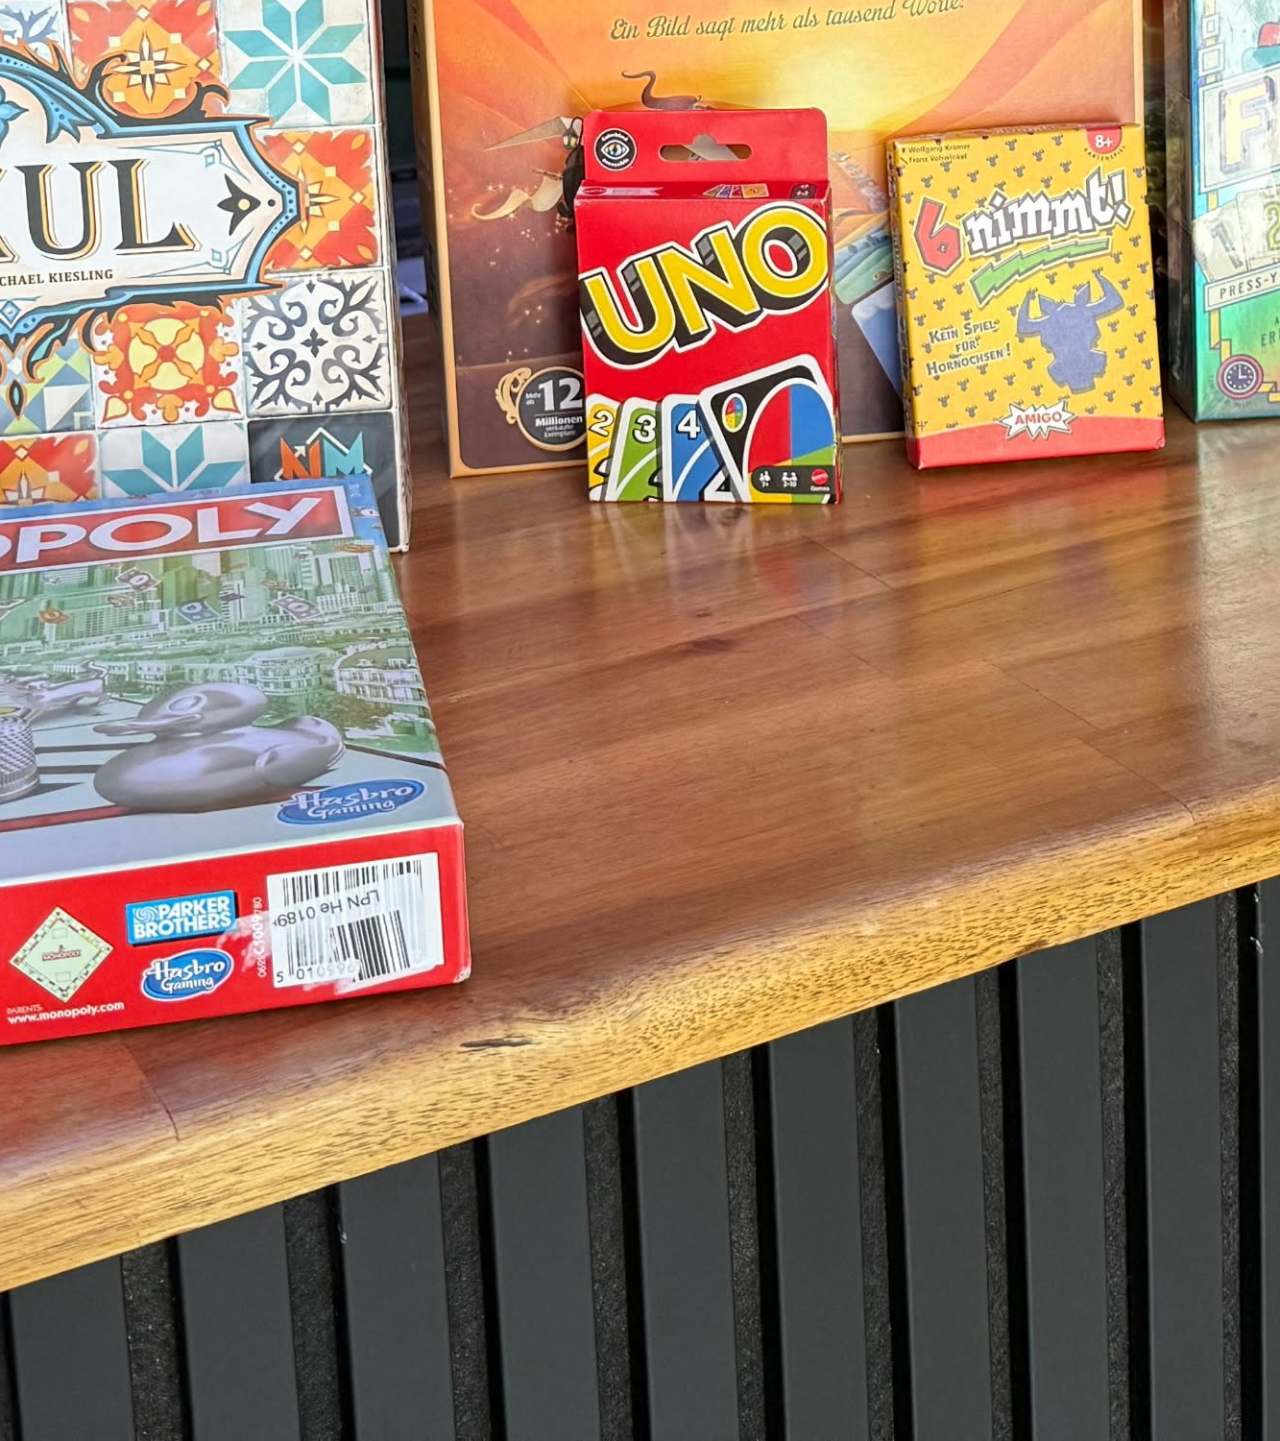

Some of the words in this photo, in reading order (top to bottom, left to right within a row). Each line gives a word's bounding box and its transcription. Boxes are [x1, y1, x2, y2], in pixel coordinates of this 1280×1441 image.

[610, 17, 639, 41] Ein
[646, 13, 689, 40] Bild
[695, 15, 736, 41] sagt
[741, 12, 785, 33] mehr
[793, 6, 821, 29] als
[1094, 134, 1113, 149] 8+
[915, 197, 964, 274] 6
[962, 167, 1132, 256] nimmt!
[48, 268, 114, 284] KIESLING
[580, 203, 828, 364] UNO
[538, 376, 583, 411] 12
[535, 415, 583, 427] Millionen
[1014, 410, 1063, 426] AMIGO
[282, 785, 414, 810] Hasbro
[307, 799, 397, 820] Gaming
[159, 896, 231, 920] PARKER
[320, 899, 342, 914] He
[347, 889, 380, 909] LPN
[133, 912, 232, 937] BROTHERS
[146, 958, 226, 982] Hasbro
[161, 975, 216, 994] Gaming
[7, 1000, 125, 1024] www.monopoly.com
